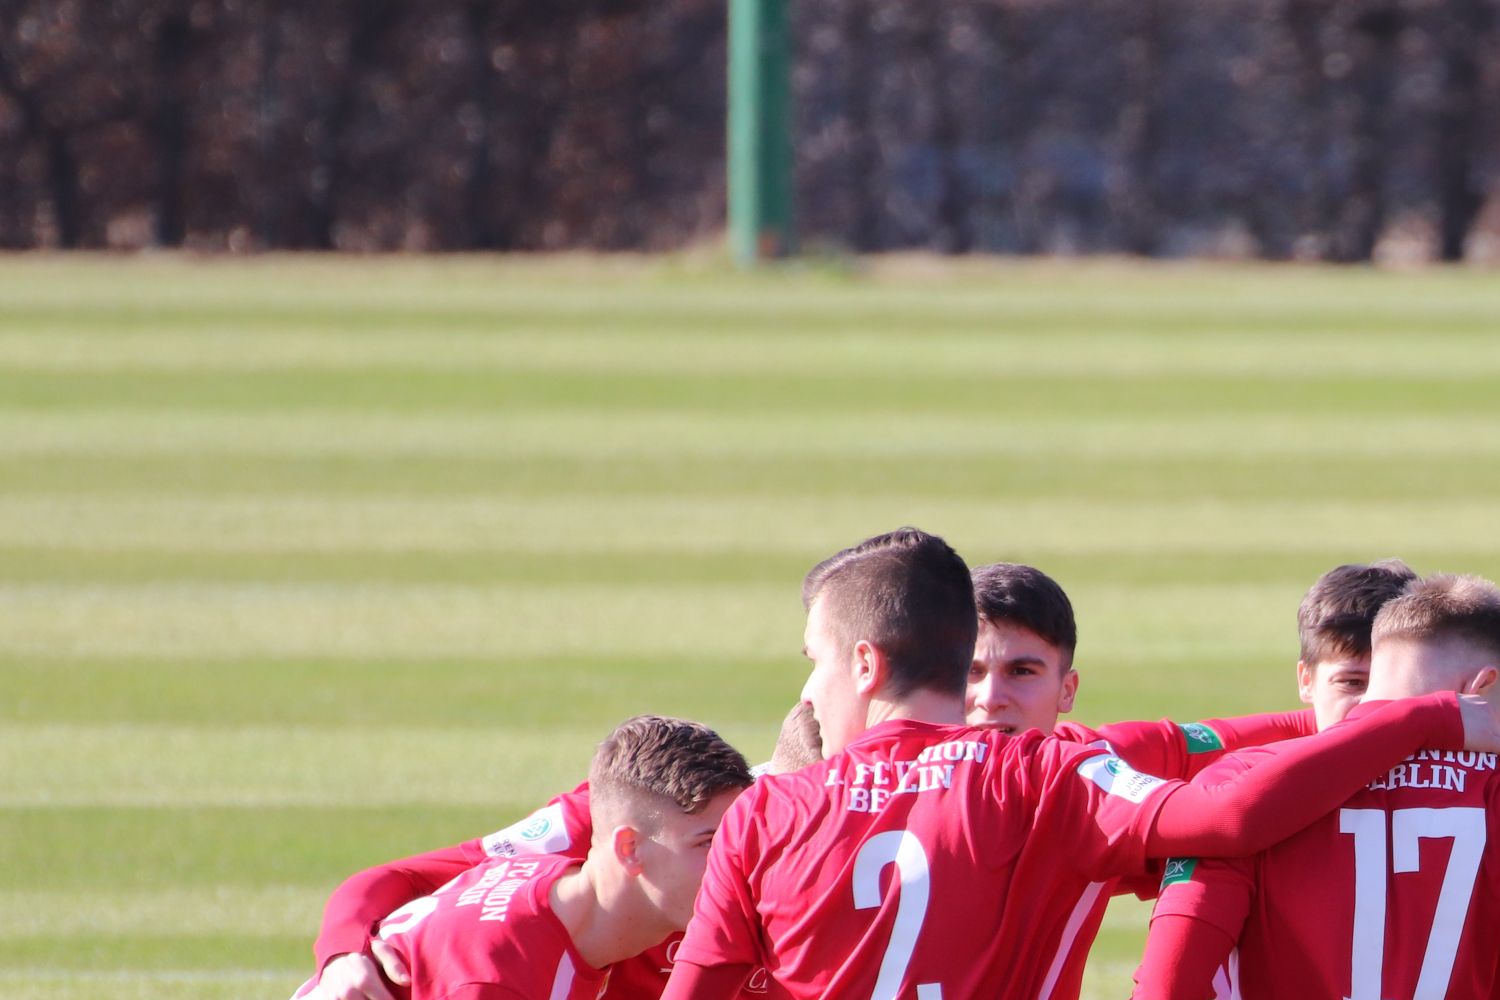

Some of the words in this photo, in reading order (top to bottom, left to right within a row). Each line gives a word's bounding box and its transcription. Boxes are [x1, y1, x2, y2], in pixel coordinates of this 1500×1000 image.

[853, 761, 890, 785] FC
[1366, 763, 1467, 793] ERLIN
[507, 861, 539, 878] FC
[479, 879, 529, 922] UNION
